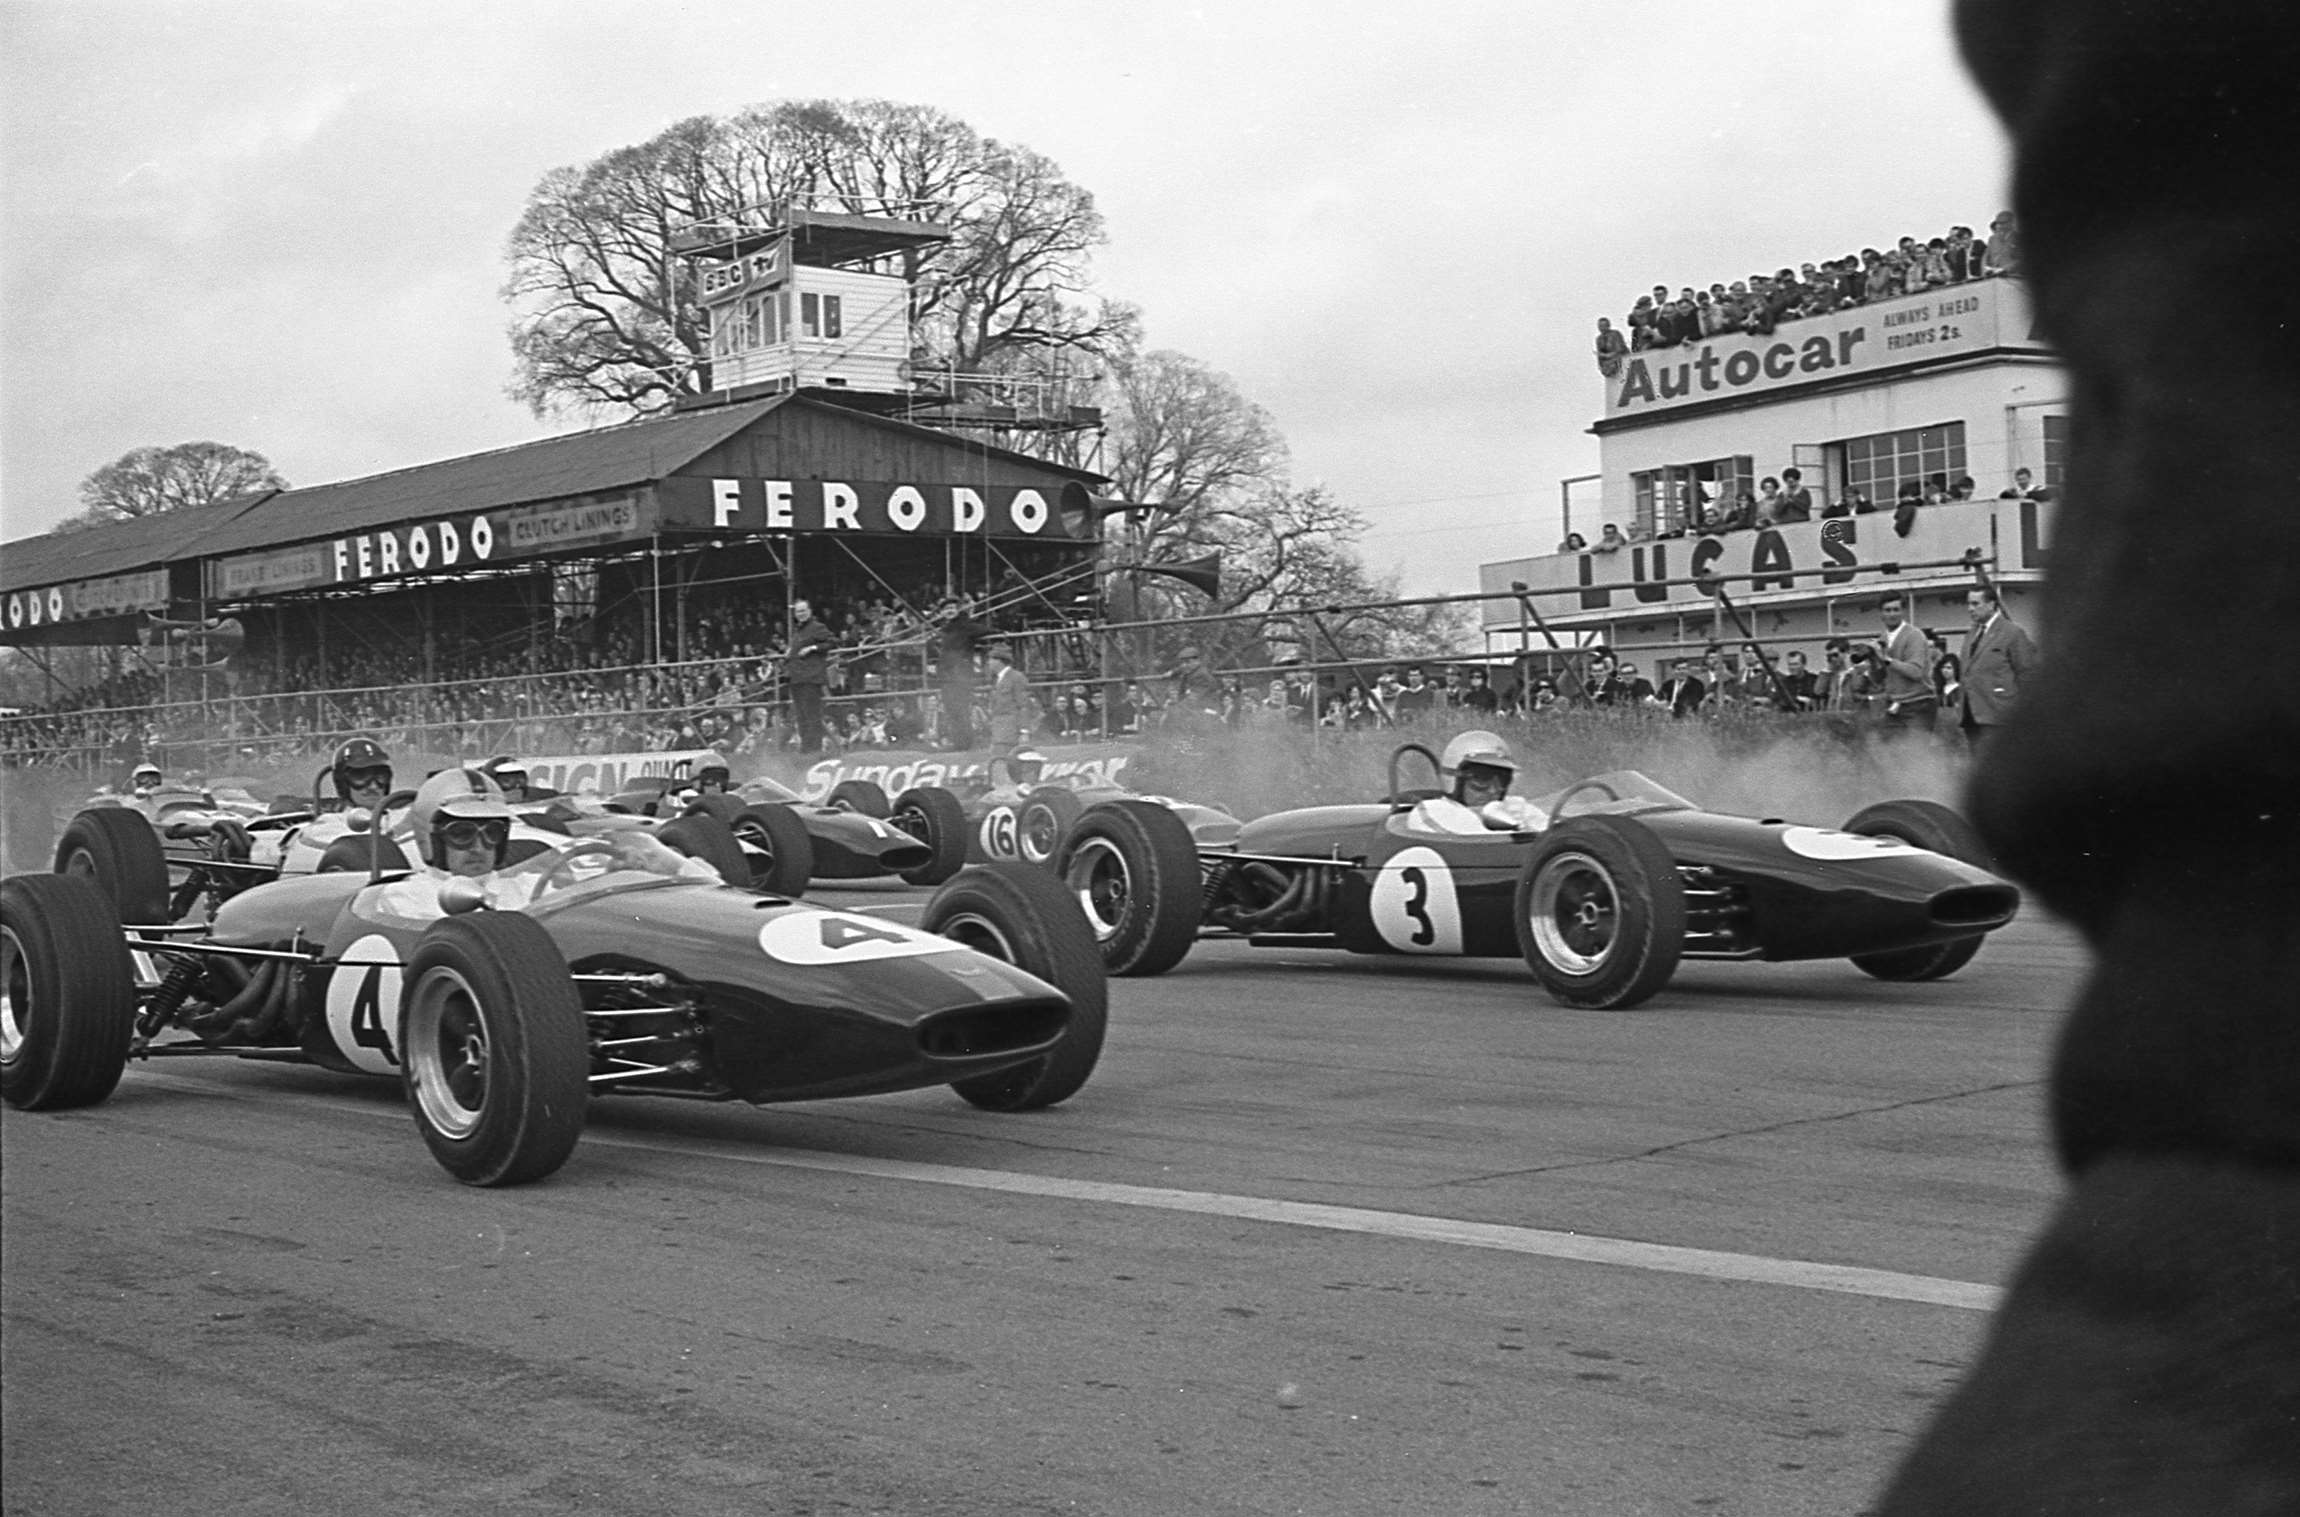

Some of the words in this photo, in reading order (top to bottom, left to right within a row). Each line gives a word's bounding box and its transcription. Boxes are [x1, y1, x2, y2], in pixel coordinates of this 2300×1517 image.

[706, 264, 741, 292] BBC
[1883, 305, 1929, 328] ALWAYS
[1939, 296, 1979, 317] AHEAD
[1887, 328, 1935, 350] FRIDAYS
[1617, 327, 1865, 408] Autocar
[516, 518, 568, 540] CLUTCH
[574, 506, 630, 531] LININGS
[712, 479, 1048, 533] FERODO
[333, 515, 493, 582] FERODO
[1578, 519, 1858, 610] LUCAS
[0, 587, 63, 630] ODO
[987, 811, 1015, 857] 16
[1401, 866, 1435, 946] 3
[820, 917, 914, 950] 4
[351, 964, 401, 1066] 4
